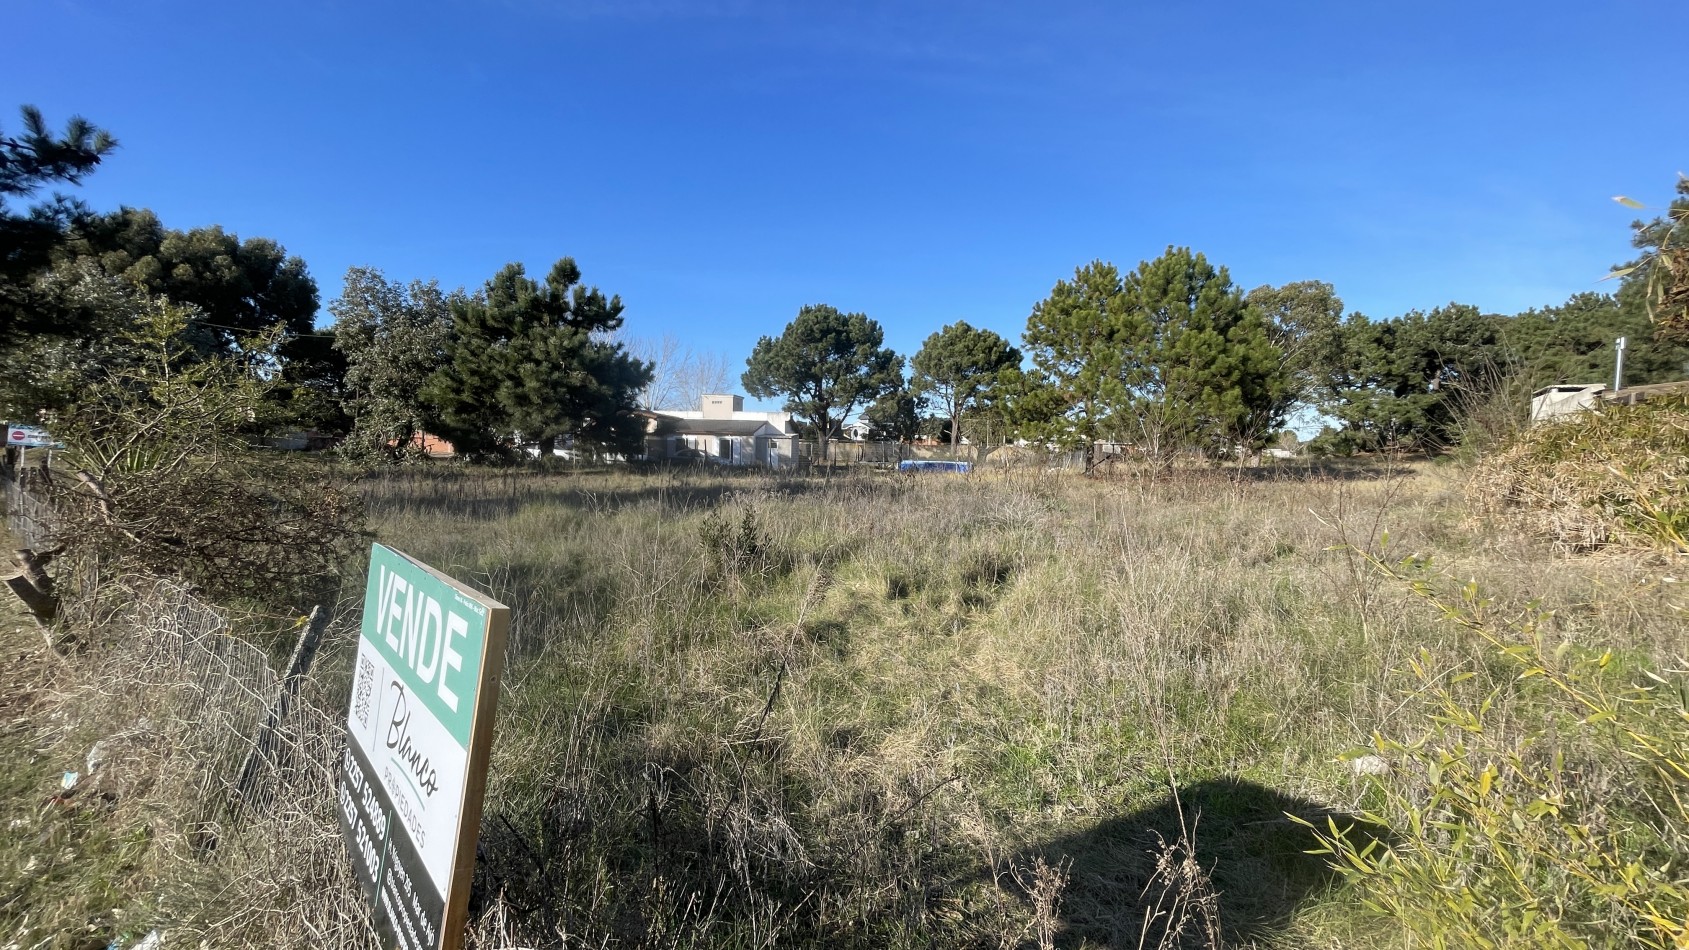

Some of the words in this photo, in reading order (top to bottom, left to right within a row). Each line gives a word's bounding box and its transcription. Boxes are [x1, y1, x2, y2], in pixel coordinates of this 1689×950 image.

[376, 564, 469, 714] VENDE
[386, 680, 438, 798] Blanco
[343, 789, 358, 830] 2257
[356, 818, 380, 883] 521003
[348, 755, 364, 793] 2257
[362, 781, 387, 840] 524889
[384, 766, 426, 849] PROPIEDADES
[420, 910, 427, 931] de
